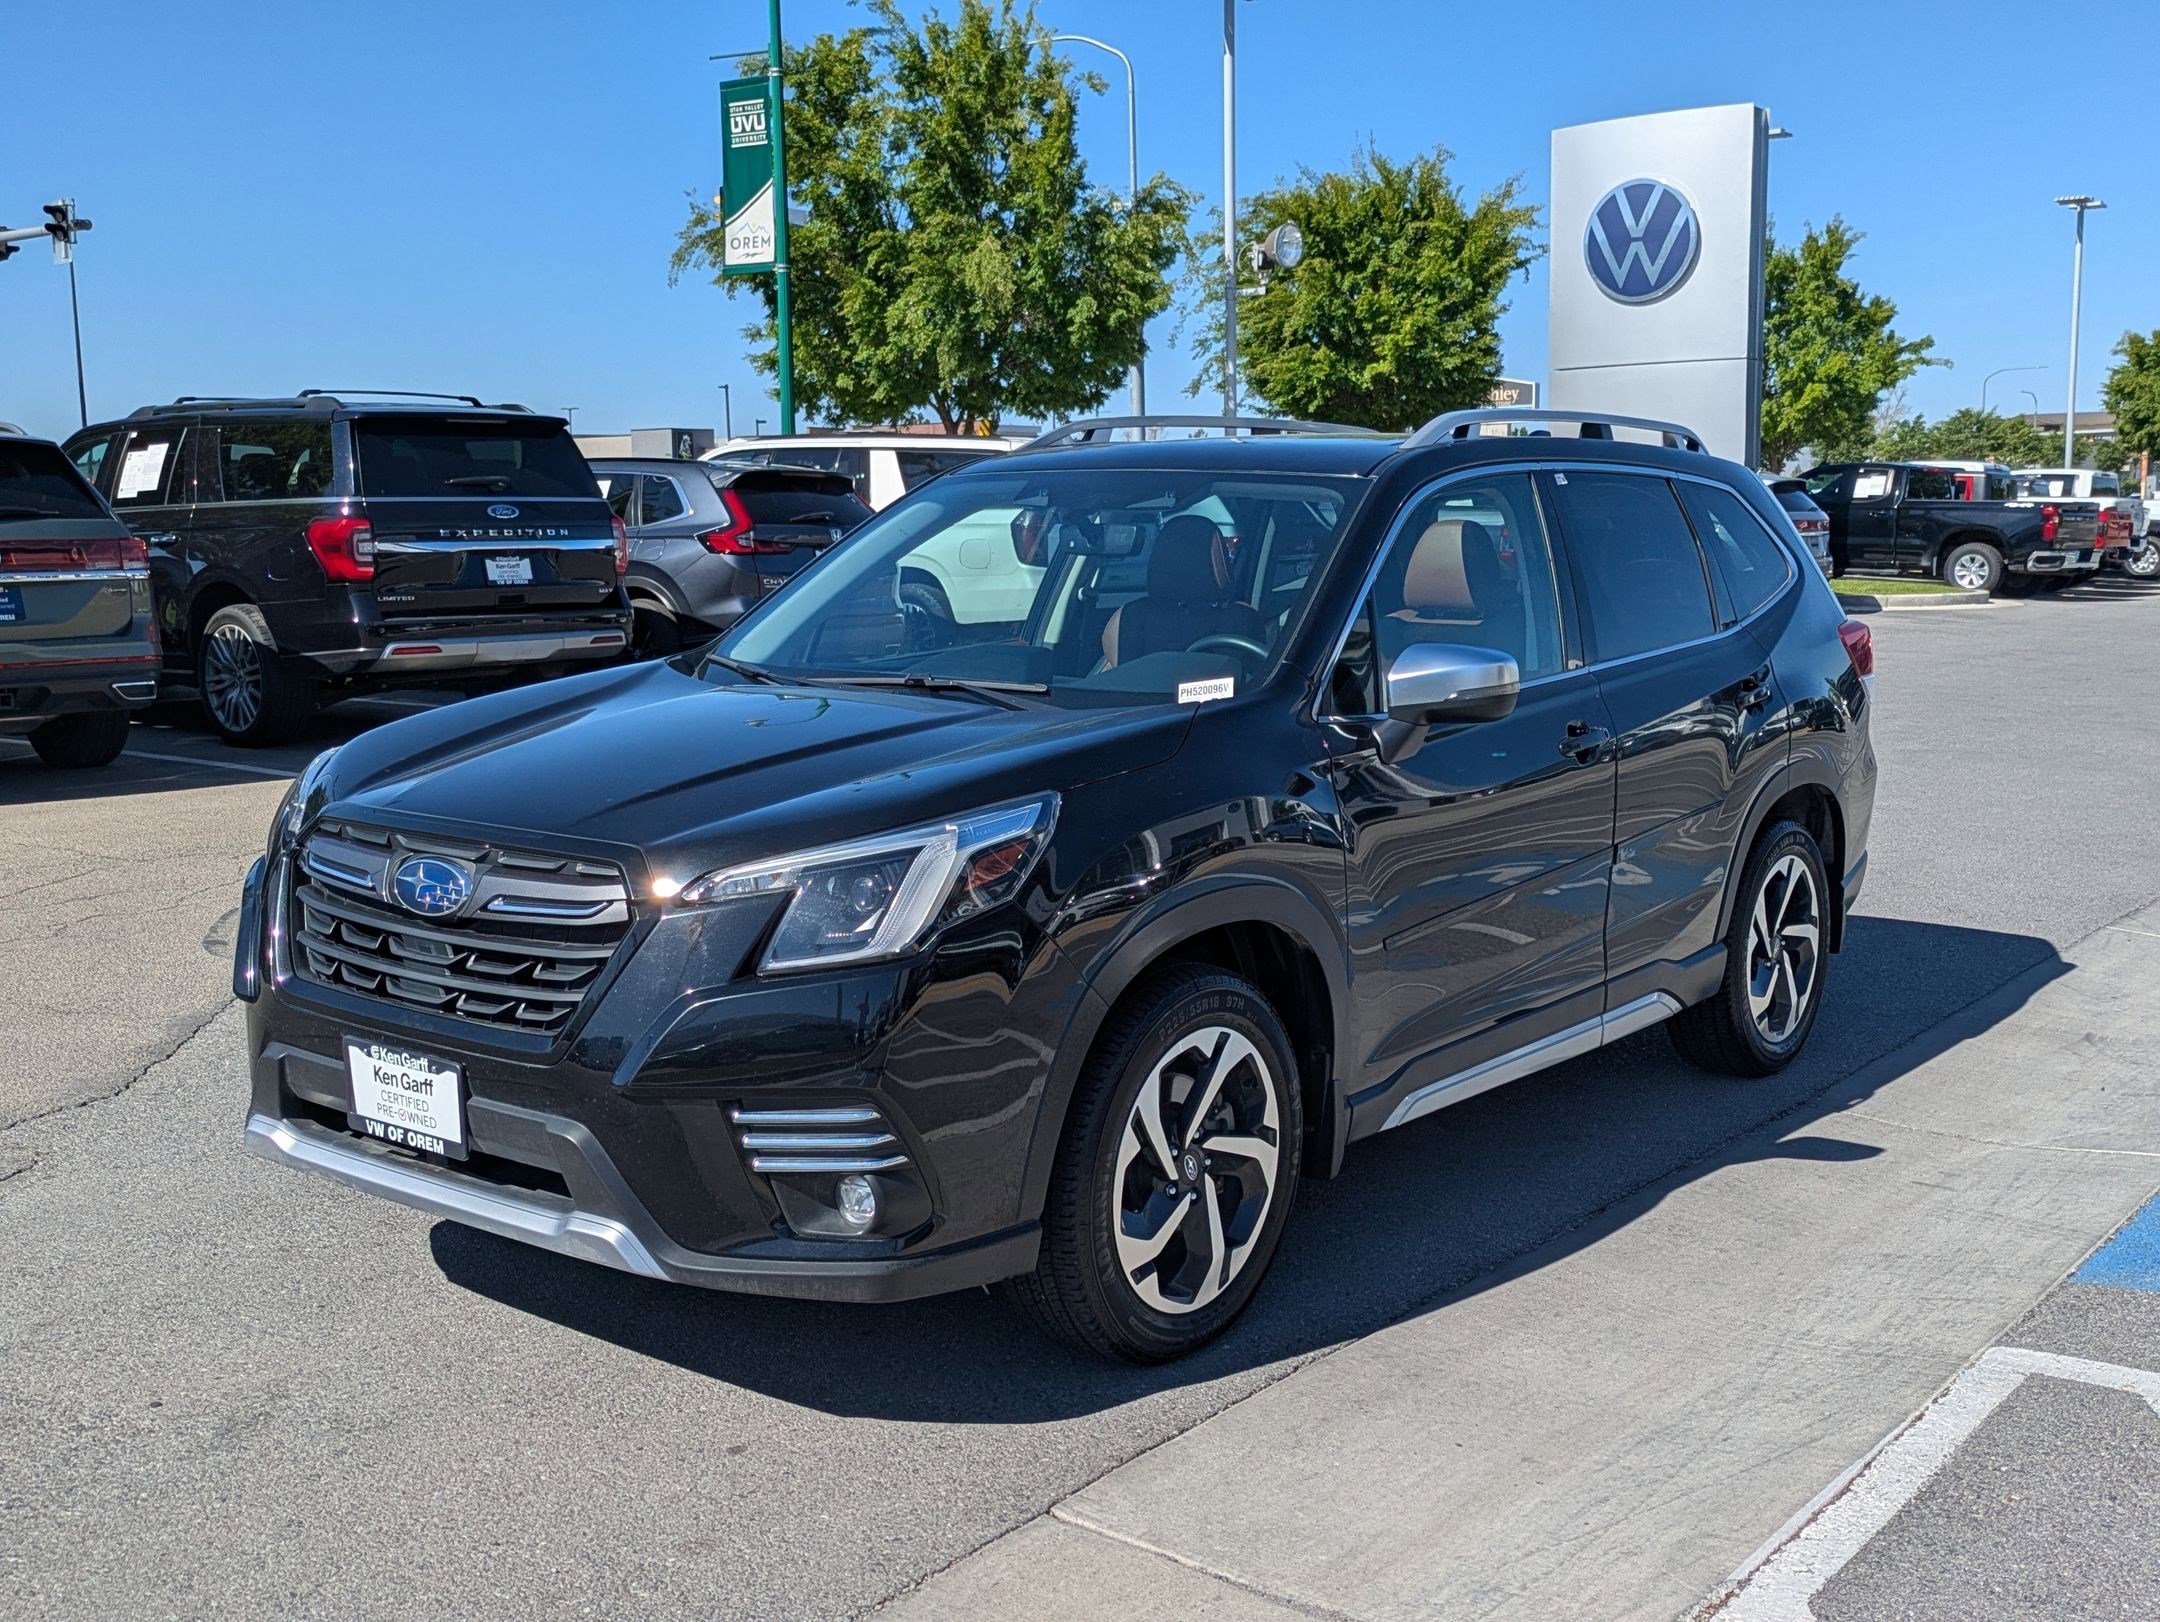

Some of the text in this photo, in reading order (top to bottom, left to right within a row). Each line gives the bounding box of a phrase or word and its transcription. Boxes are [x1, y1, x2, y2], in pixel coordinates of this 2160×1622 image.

[730, 113, 766, 134] UVU
[730, 235, 772, 250] OREM
[1487, 385, 1520, 404] hley
[440, 527, 569, 537] EXPEDITION
[379, 1047, 430, 1073] Ken Garff
[373, 1065, 434, 1097] Ken Garff
[380, 1090, 430, 1113] CERTIFIED
[365, 1119, 445, 1155] VW OF OREM
